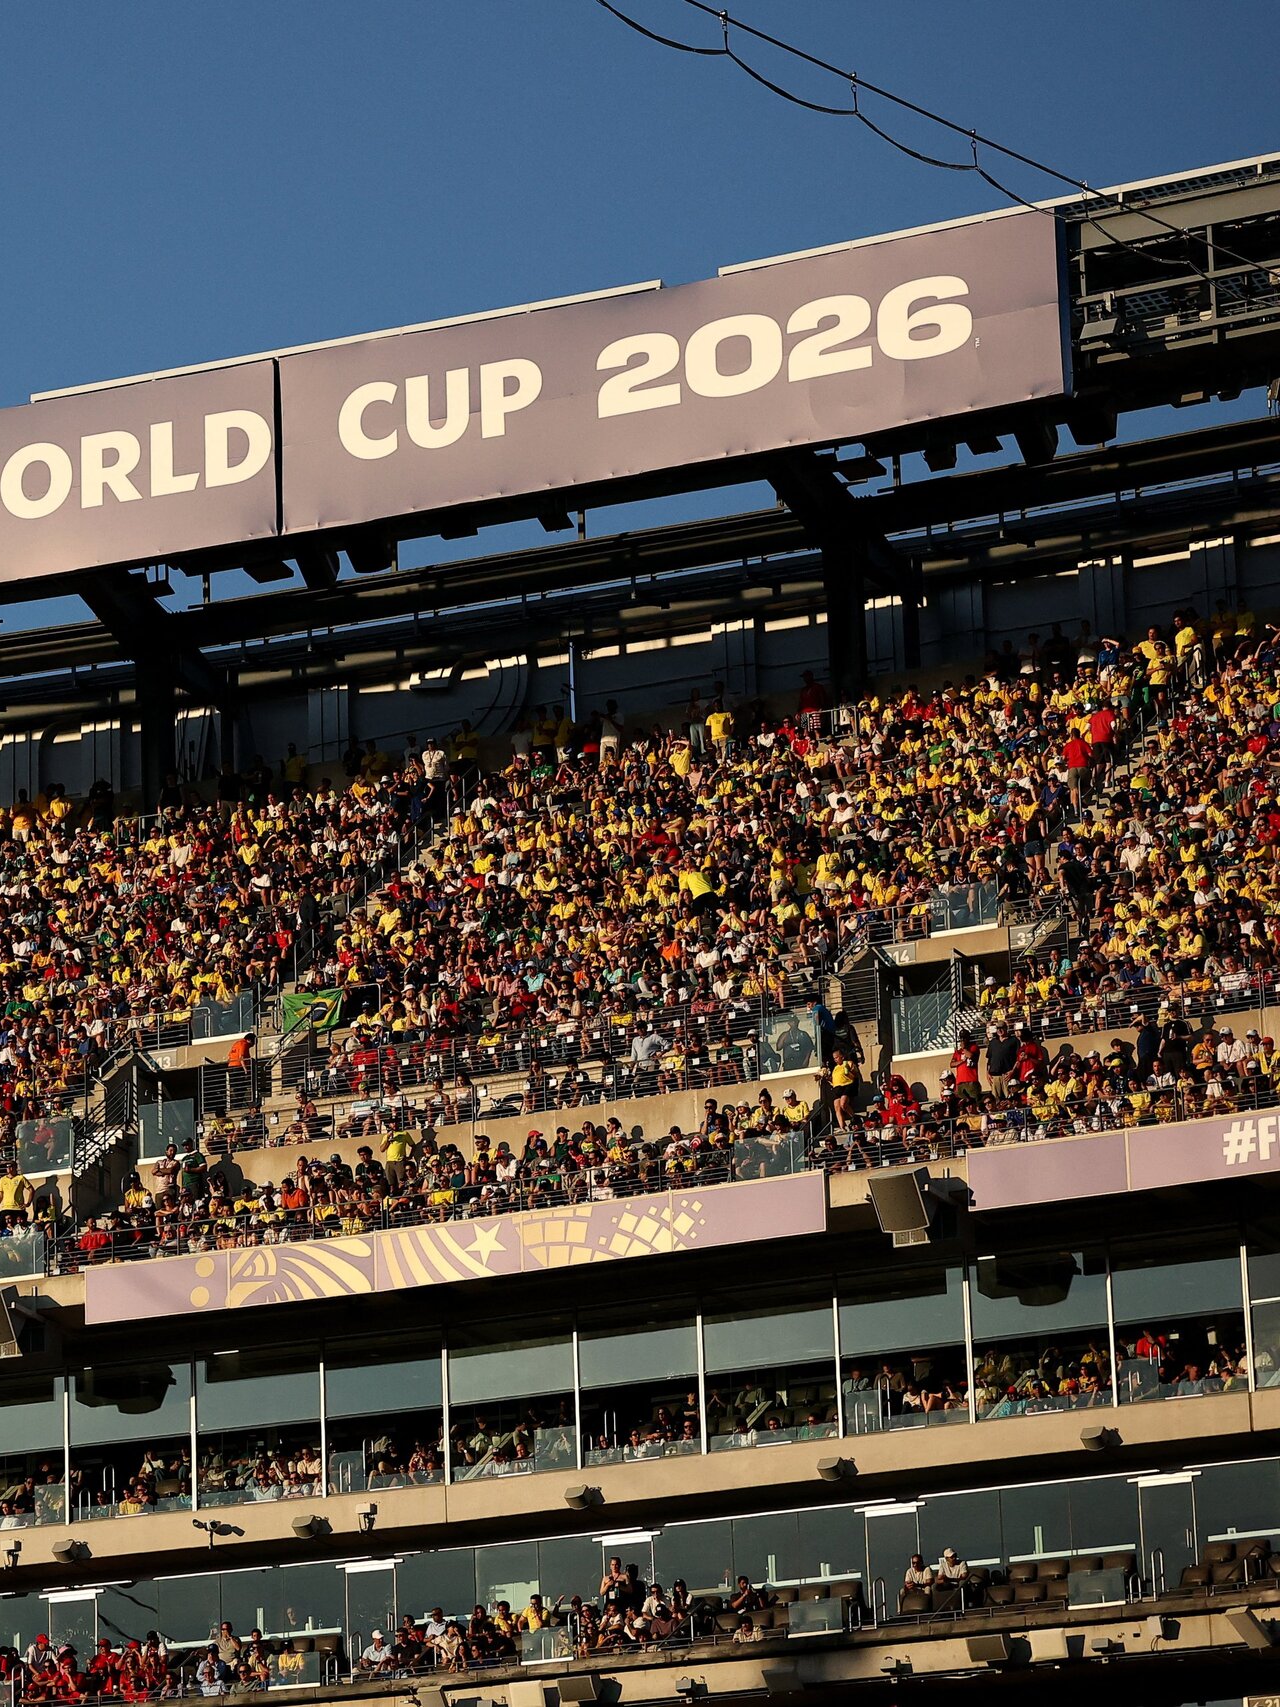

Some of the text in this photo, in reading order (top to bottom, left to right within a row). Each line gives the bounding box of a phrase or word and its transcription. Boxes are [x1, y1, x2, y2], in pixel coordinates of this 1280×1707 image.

[339, 359, 542, 459] CUP
[597, 275, 973, 419] 2026
[1223, 1115, 1280, 1165] #F
